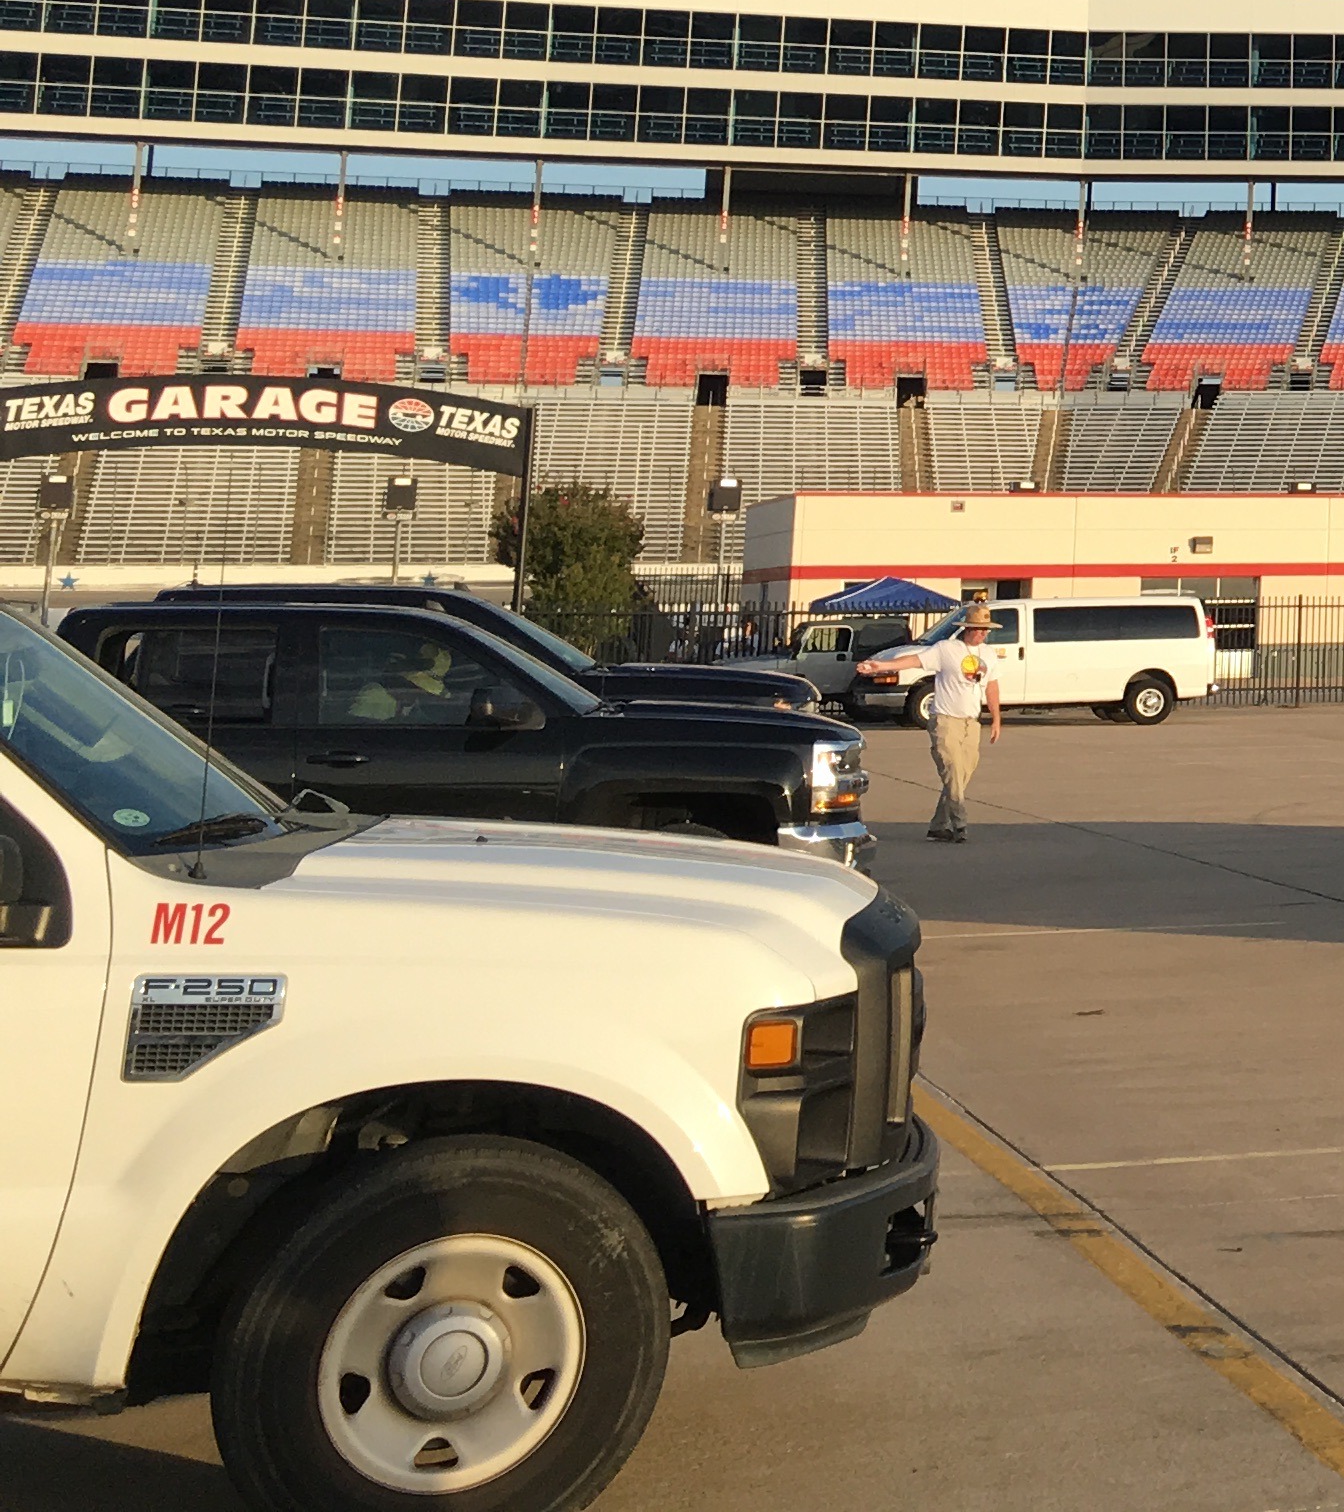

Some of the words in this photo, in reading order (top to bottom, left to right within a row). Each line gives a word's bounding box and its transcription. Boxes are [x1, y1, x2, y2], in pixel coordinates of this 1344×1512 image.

[4, 391, 95, 422] TEXAS
[108, 385, 379, 430] GARAGE
[4, 419, 40, 432] MOTOR
[435, 426, 467, 440] MOTOR
[438, 405, 521, 439] TEXAS
[72, 429, 159, 442] WELCOME
[163, 428, 186, 437] TO
[190, 427, 247, 437] TEXAS
[251, 428, 309, 439] MOTOR
[314, 430, 402, 446] SPEEDWAY
[150, 902, 231, 945] M12
[143, 978, 278, 996] F-250
